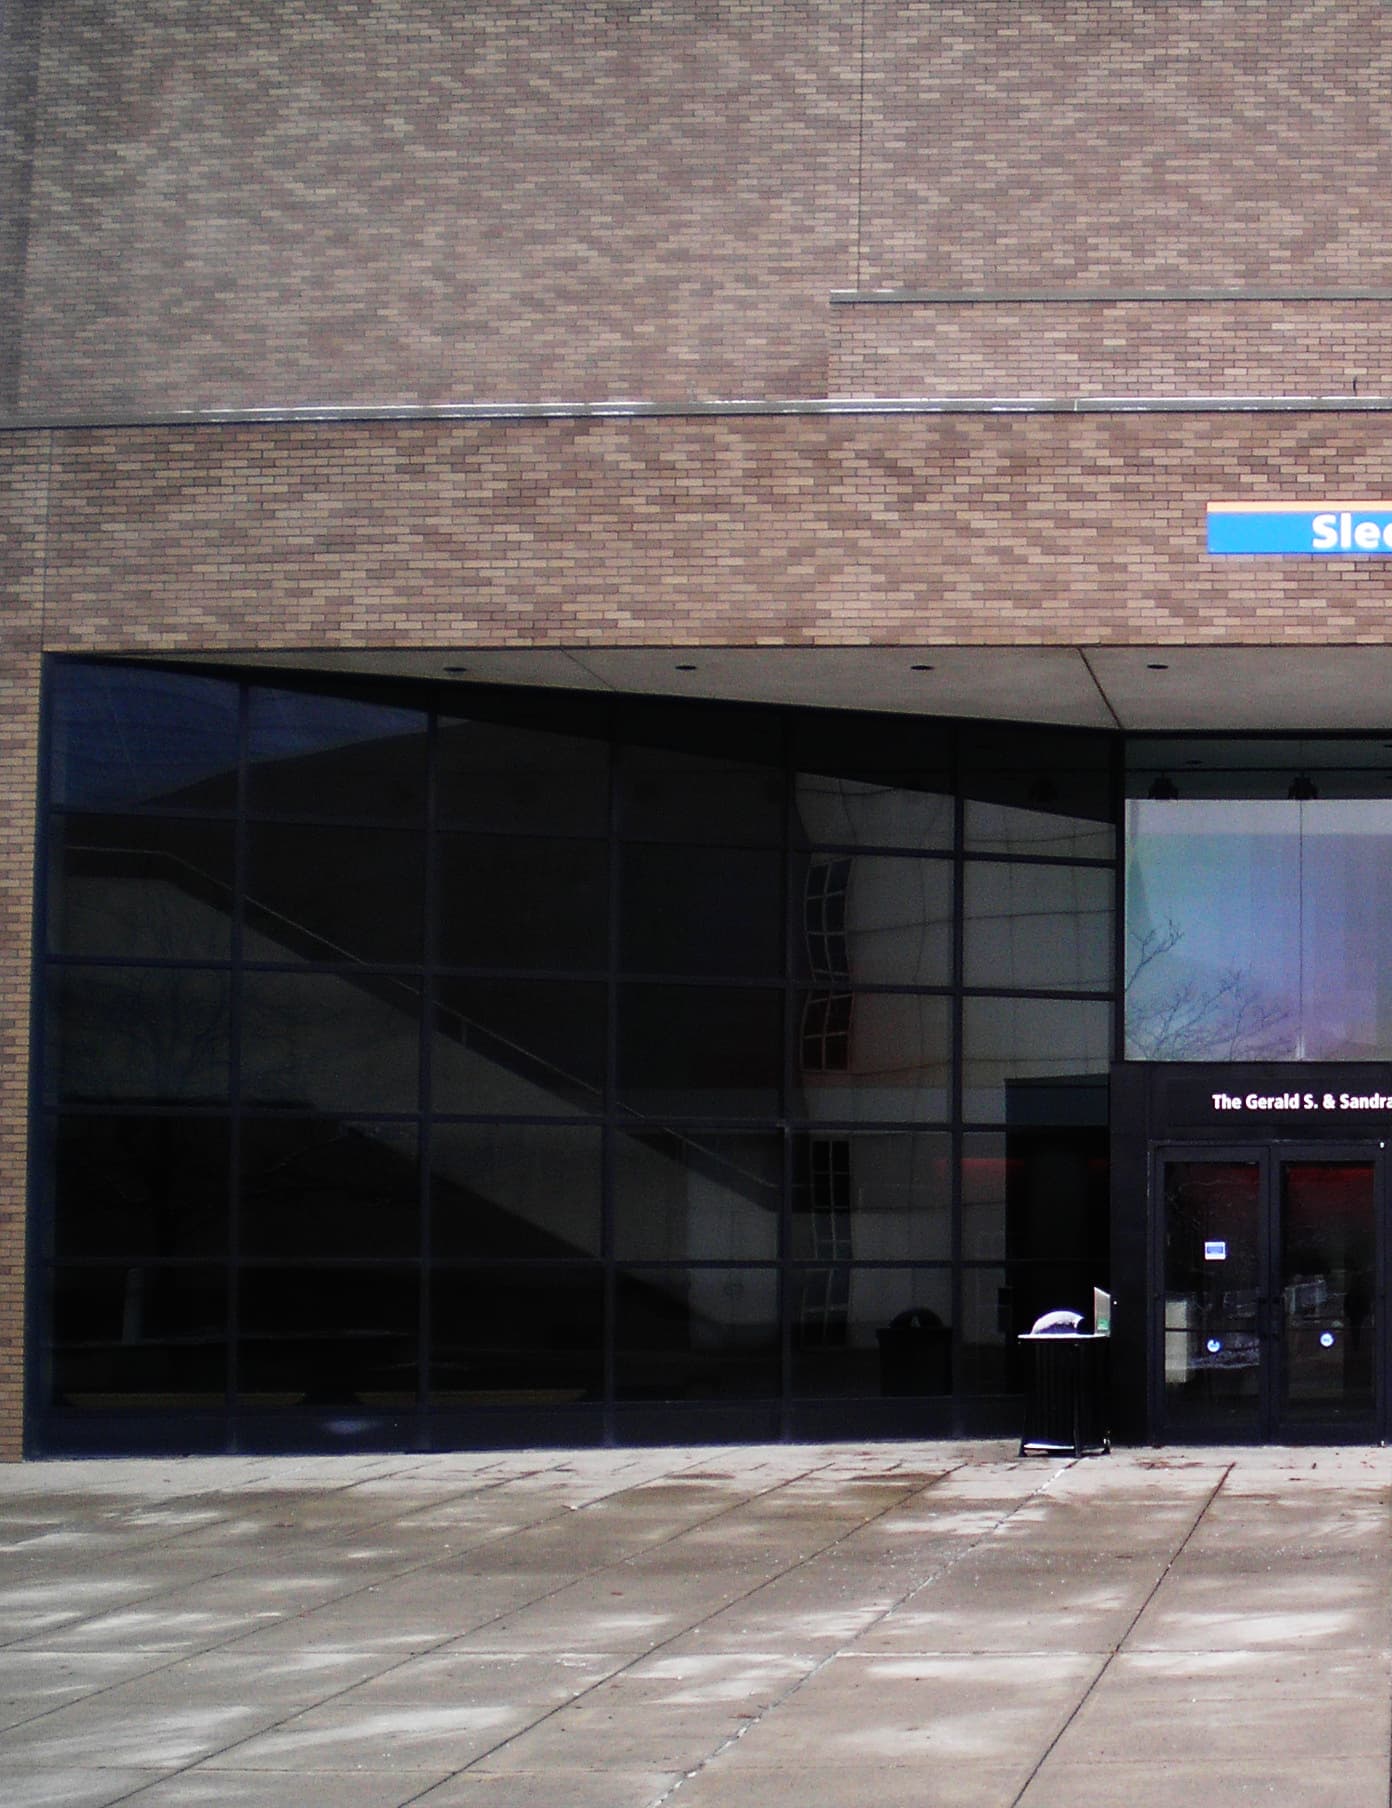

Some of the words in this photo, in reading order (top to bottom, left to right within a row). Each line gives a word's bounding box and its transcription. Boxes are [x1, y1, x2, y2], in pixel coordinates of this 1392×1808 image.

[1211, 1093, 1242, 1110] The
[1245, 1092, 1299, 1110] Gerald
[1303, 1093, 1319, 1110] S.
[1322, 1093, 1336, 1110] &
